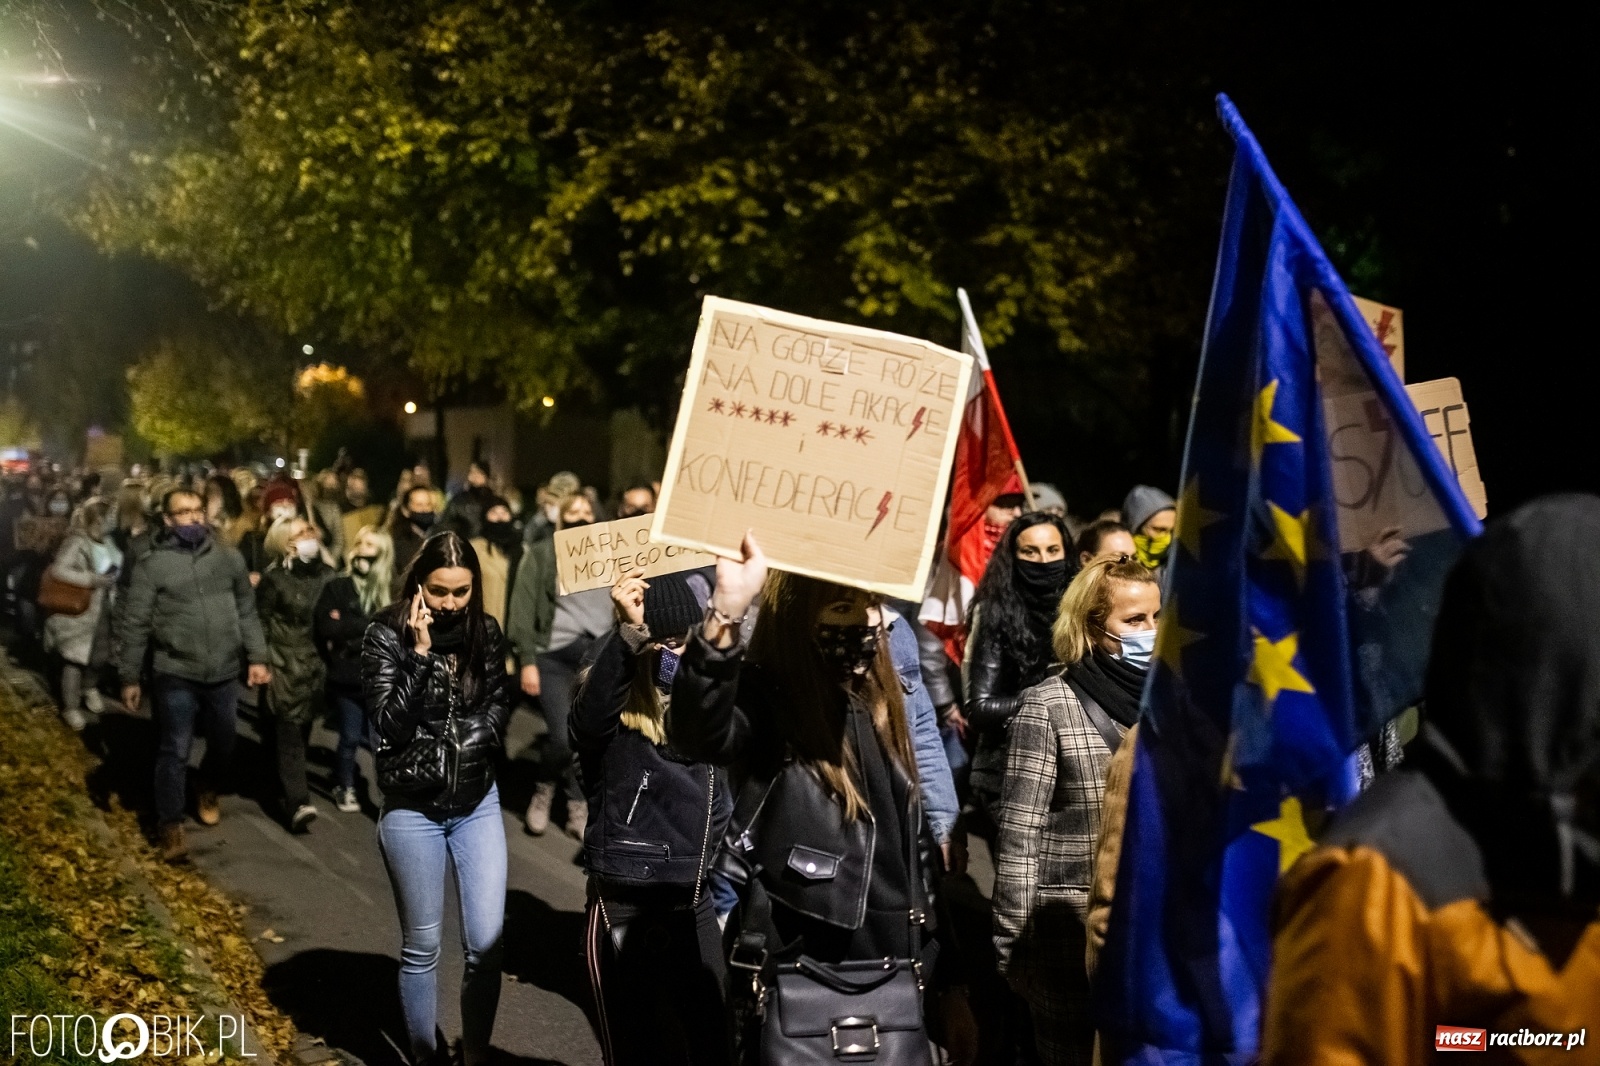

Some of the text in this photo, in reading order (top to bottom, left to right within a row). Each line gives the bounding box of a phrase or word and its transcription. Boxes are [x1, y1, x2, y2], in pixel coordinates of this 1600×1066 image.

[712, 319, 759, 354] NA
[702, 359, 758, 395] NA
[769, 370, 840, 413] DOLE
